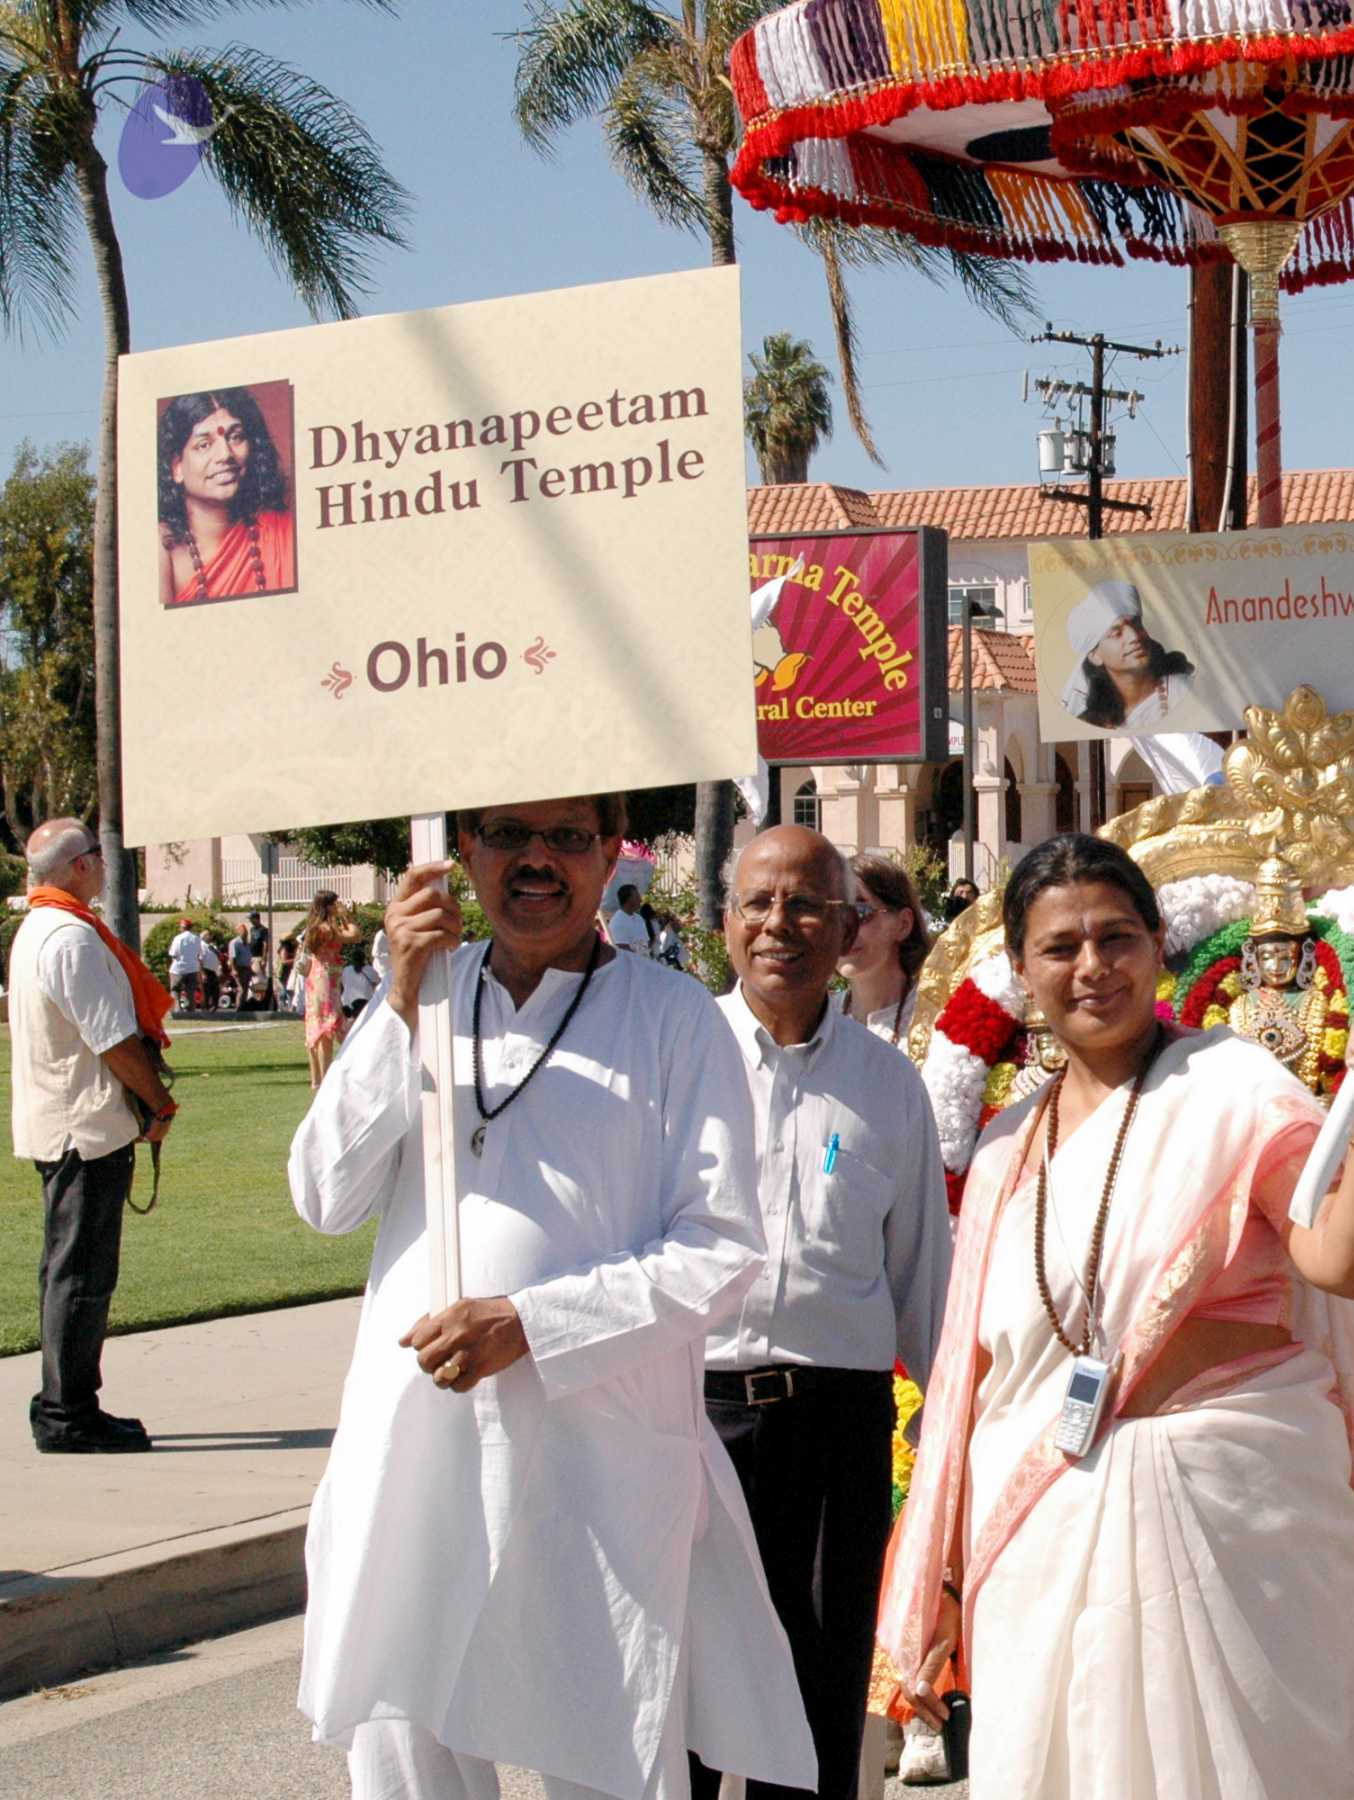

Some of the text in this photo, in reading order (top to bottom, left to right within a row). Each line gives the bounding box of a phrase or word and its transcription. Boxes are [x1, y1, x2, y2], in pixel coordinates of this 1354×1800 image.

[309, 387, 709, 470] Dhyanapeetam
[315, 440, 705, 529] Hindu Temple
[366, 633, 507, 692] Ohio
[826, 565, 909, 691] Temple
[796, 696, 877, 719] Center
